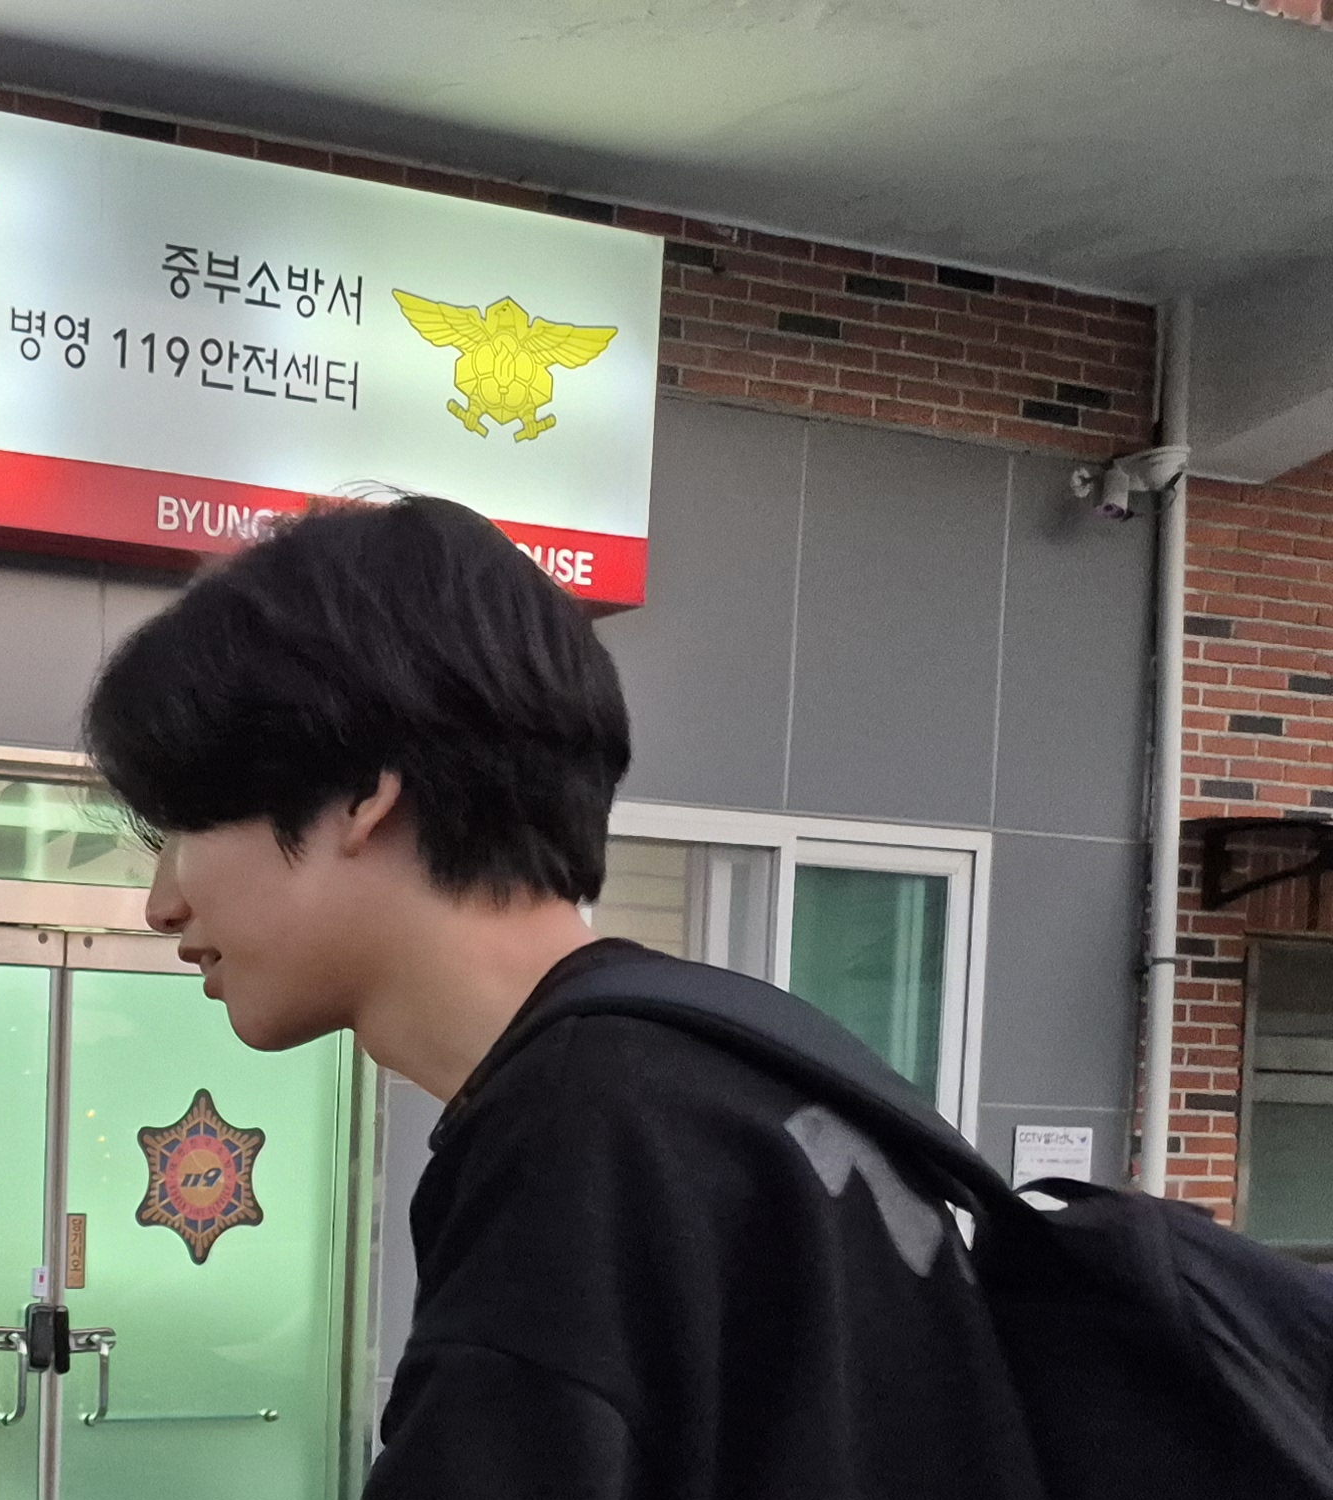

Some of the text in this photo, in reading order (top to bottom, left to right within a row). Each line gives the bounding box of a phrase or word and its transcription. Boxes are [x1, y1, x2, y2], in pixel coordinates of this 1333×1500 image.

[161, 243, 363, 326] 중부소방서
[10, 306, 91, 369] 병영
[515, 543, 595, 586] USE
[180, 1167, 223, 1187] 119
[70, 1218, 83, 1272] 당기시오
